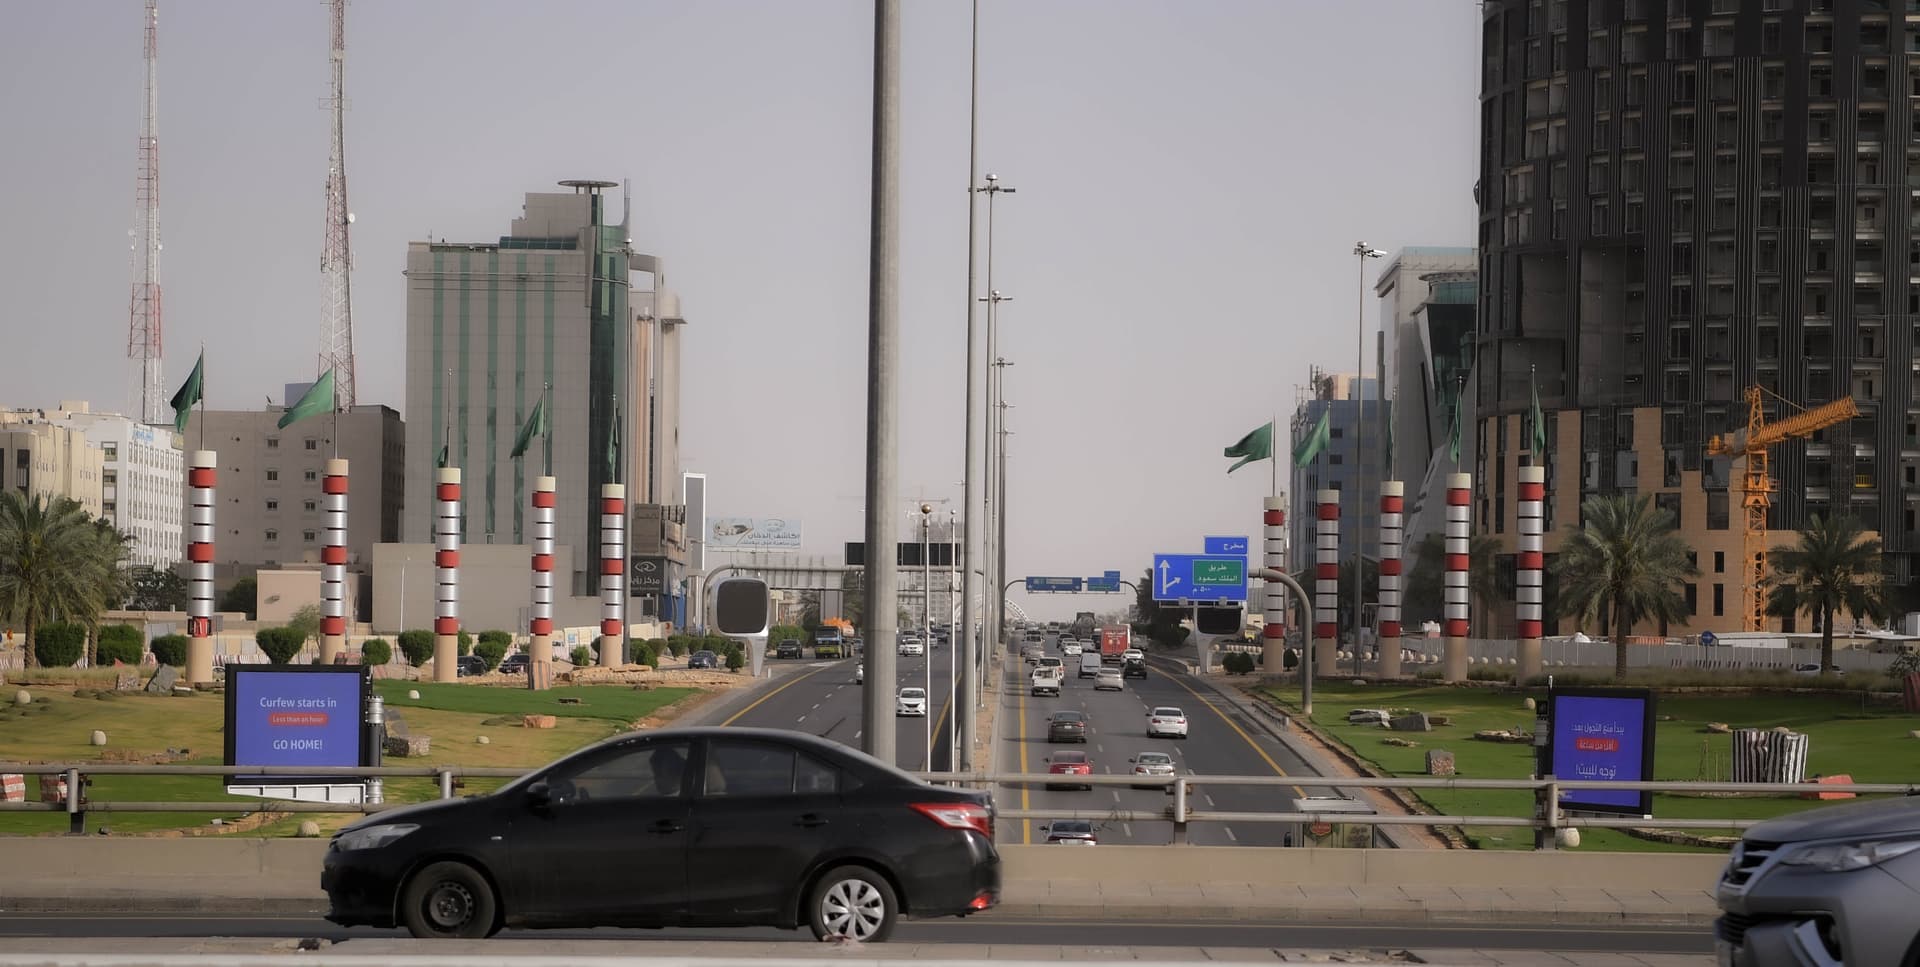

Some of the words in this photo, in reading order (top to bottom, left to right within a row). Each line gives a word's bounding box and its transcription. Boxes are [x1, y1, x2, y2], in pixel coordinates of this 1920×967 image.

[1223, 543, 1244, 551] مخرج
[1208, 563, 1227, 572] طريق
[260, 697, 295, 708] Curfew
[297, 697, 325, 708] starts
[327, 697, 337, 708] in
[272, 715, 285, 723] Less
[286, 715, 300, 723] than
[310, 715, 324, 723] hour
[272, 739, 288, 750] GO
[290, 739, 323, 750] HOME!
[1575, 763, 1598, 779] للبيت!
[1599, 765, 1616, 779] توجه
